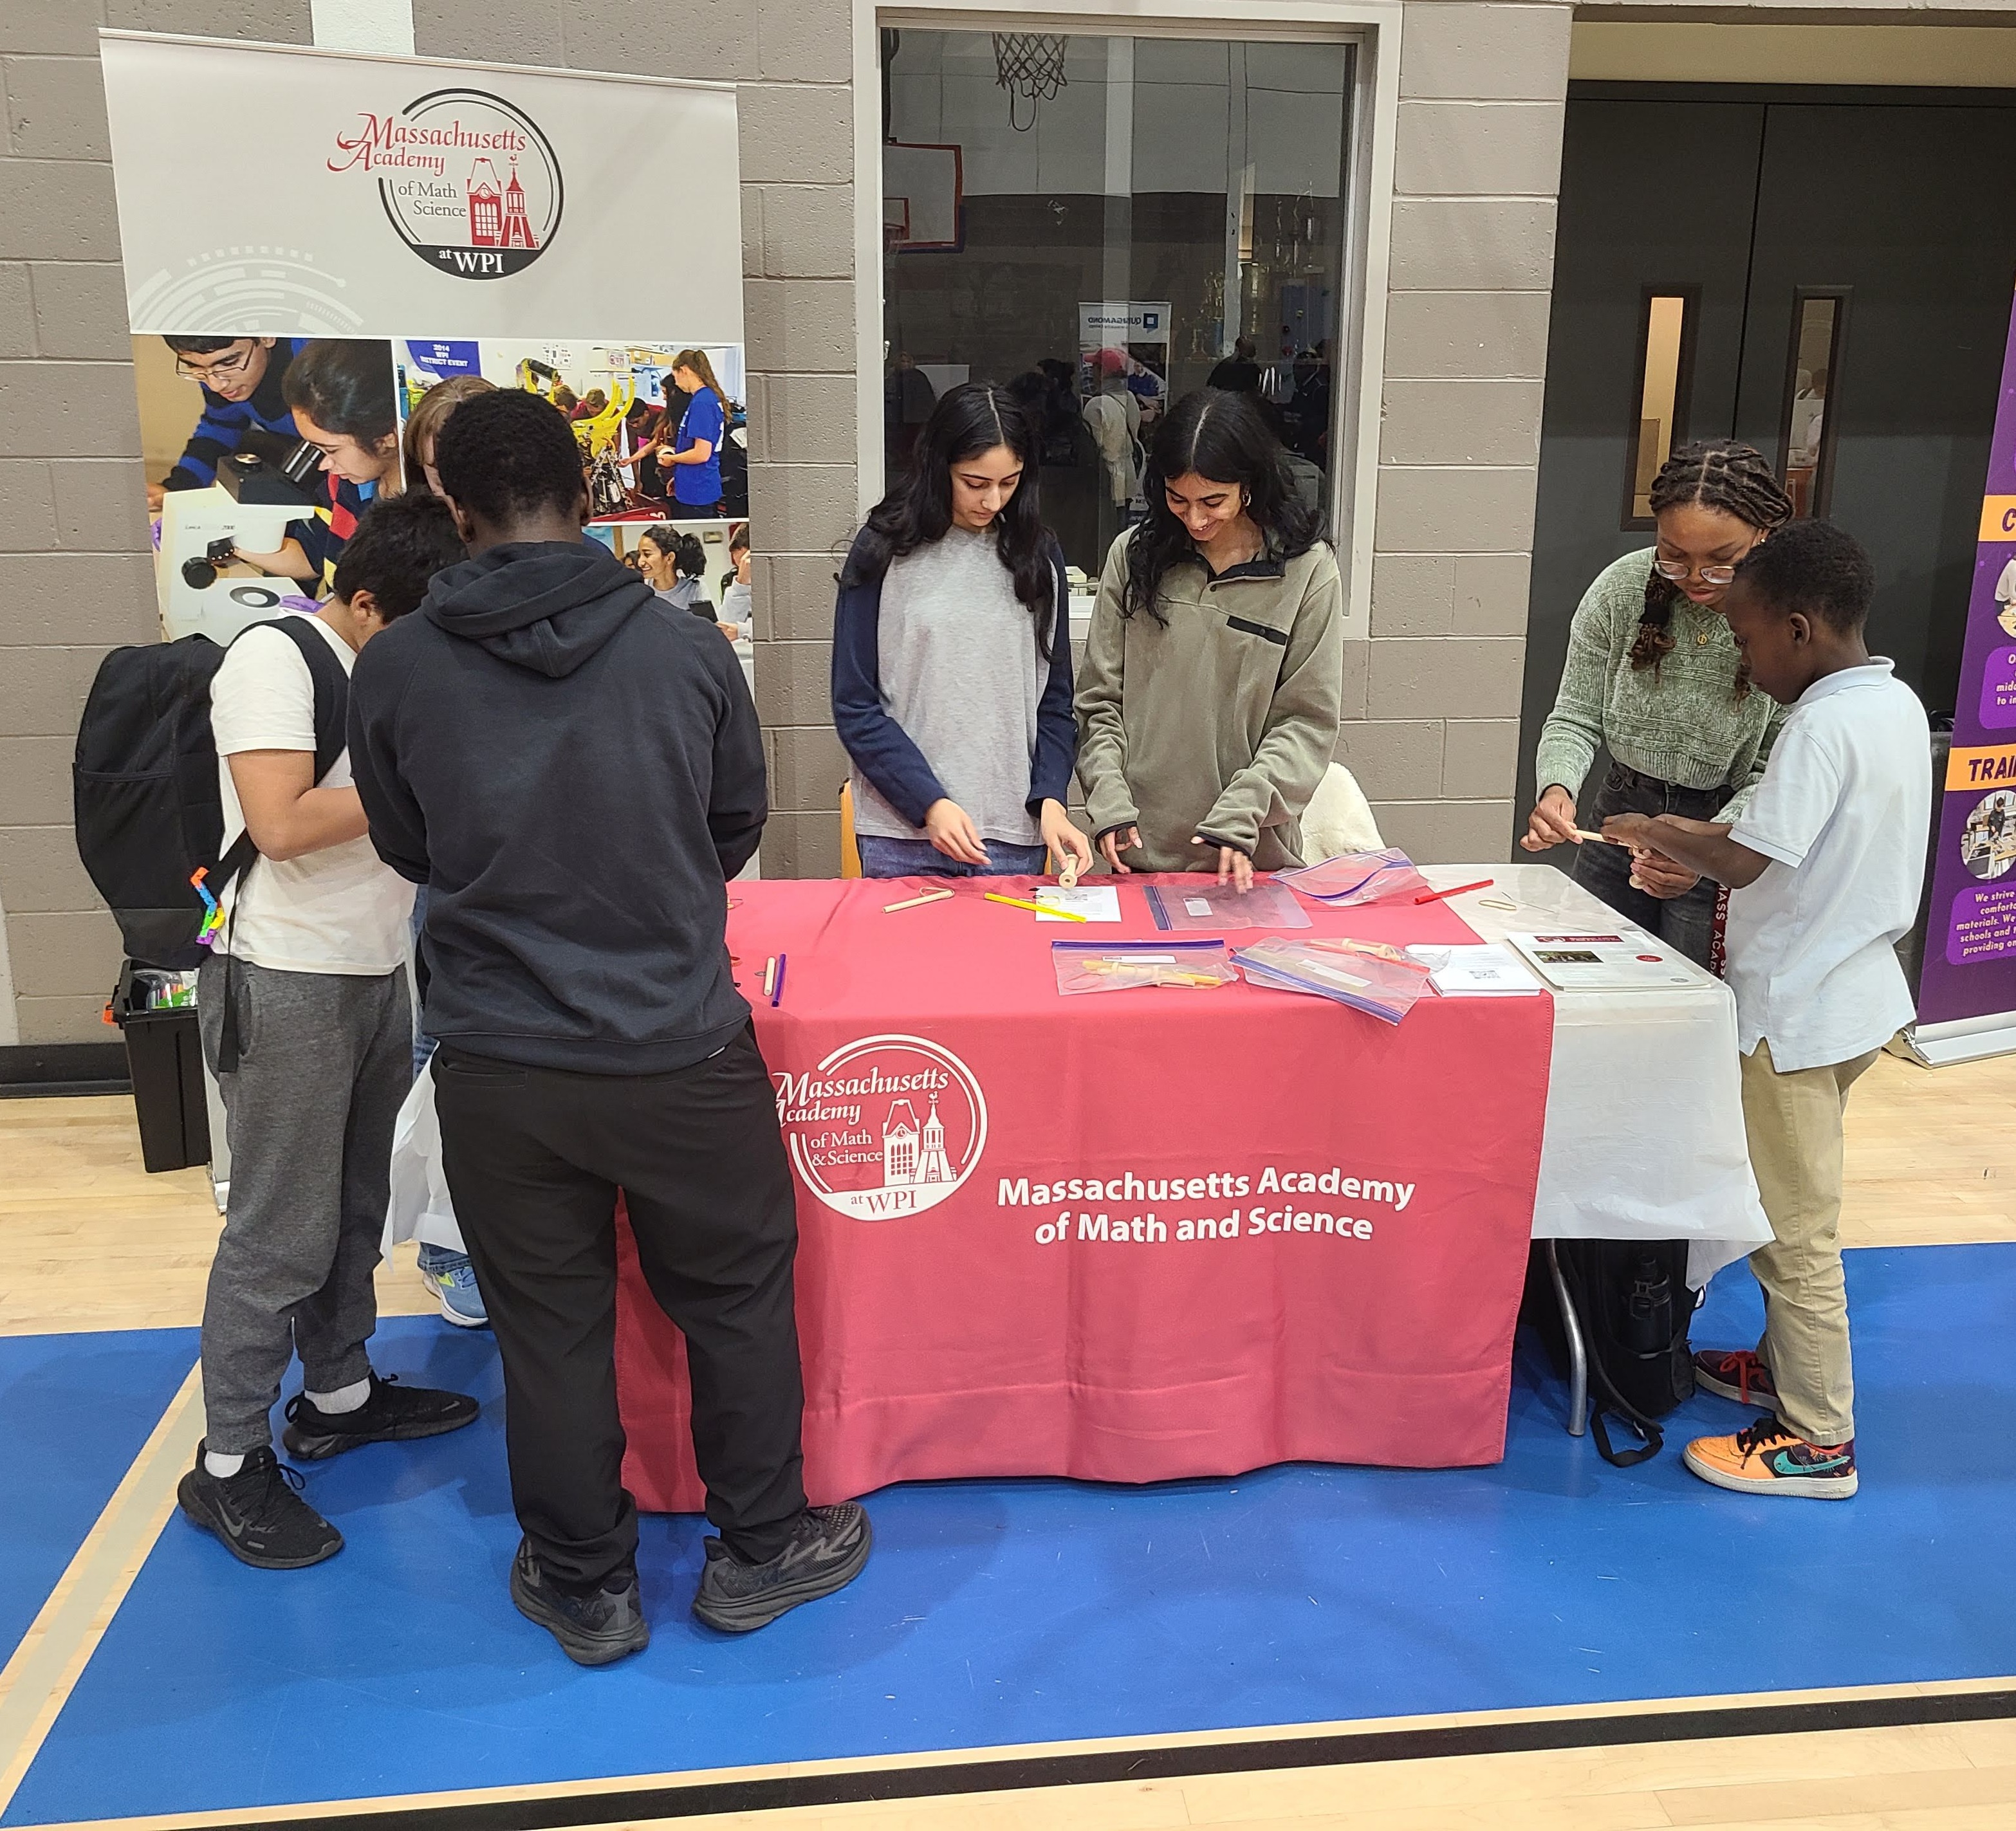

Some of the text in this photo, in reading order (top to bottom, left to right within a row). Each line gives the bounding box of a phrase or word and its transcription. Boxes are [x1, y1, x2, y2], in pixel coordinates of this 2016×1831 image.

[337, 113, 527, 152] Massachusetts
[327, 143, 445, 177] Academy
[398, 181, 458, 199] of Math
[413, 201, 467, 217] Science
[439, 249, 505, 274] at WPI
[1997, 696, 2007, 706] to
[1968, 755, 2016, 782] TRAI
[1975, 890, 2015, 903] We strive
[2002, 914, 2016, 923] We
[1960, 929, 1992, 943] schools
[1993, 925, 2011, 937] and
[1710, 930, 1723, 975] ACAD
[1963, 940, 2004, 957] providing
[772, 1066, 949, 1107] Massachusetts
[811, 1129, 873, 1149] of Math
[997, 1166, 1416, 1211] Massachusetts Academy
[851, 1190, 917, 1214] at WPI
[1035, 1205, 1373, 1244] of Math and Science
